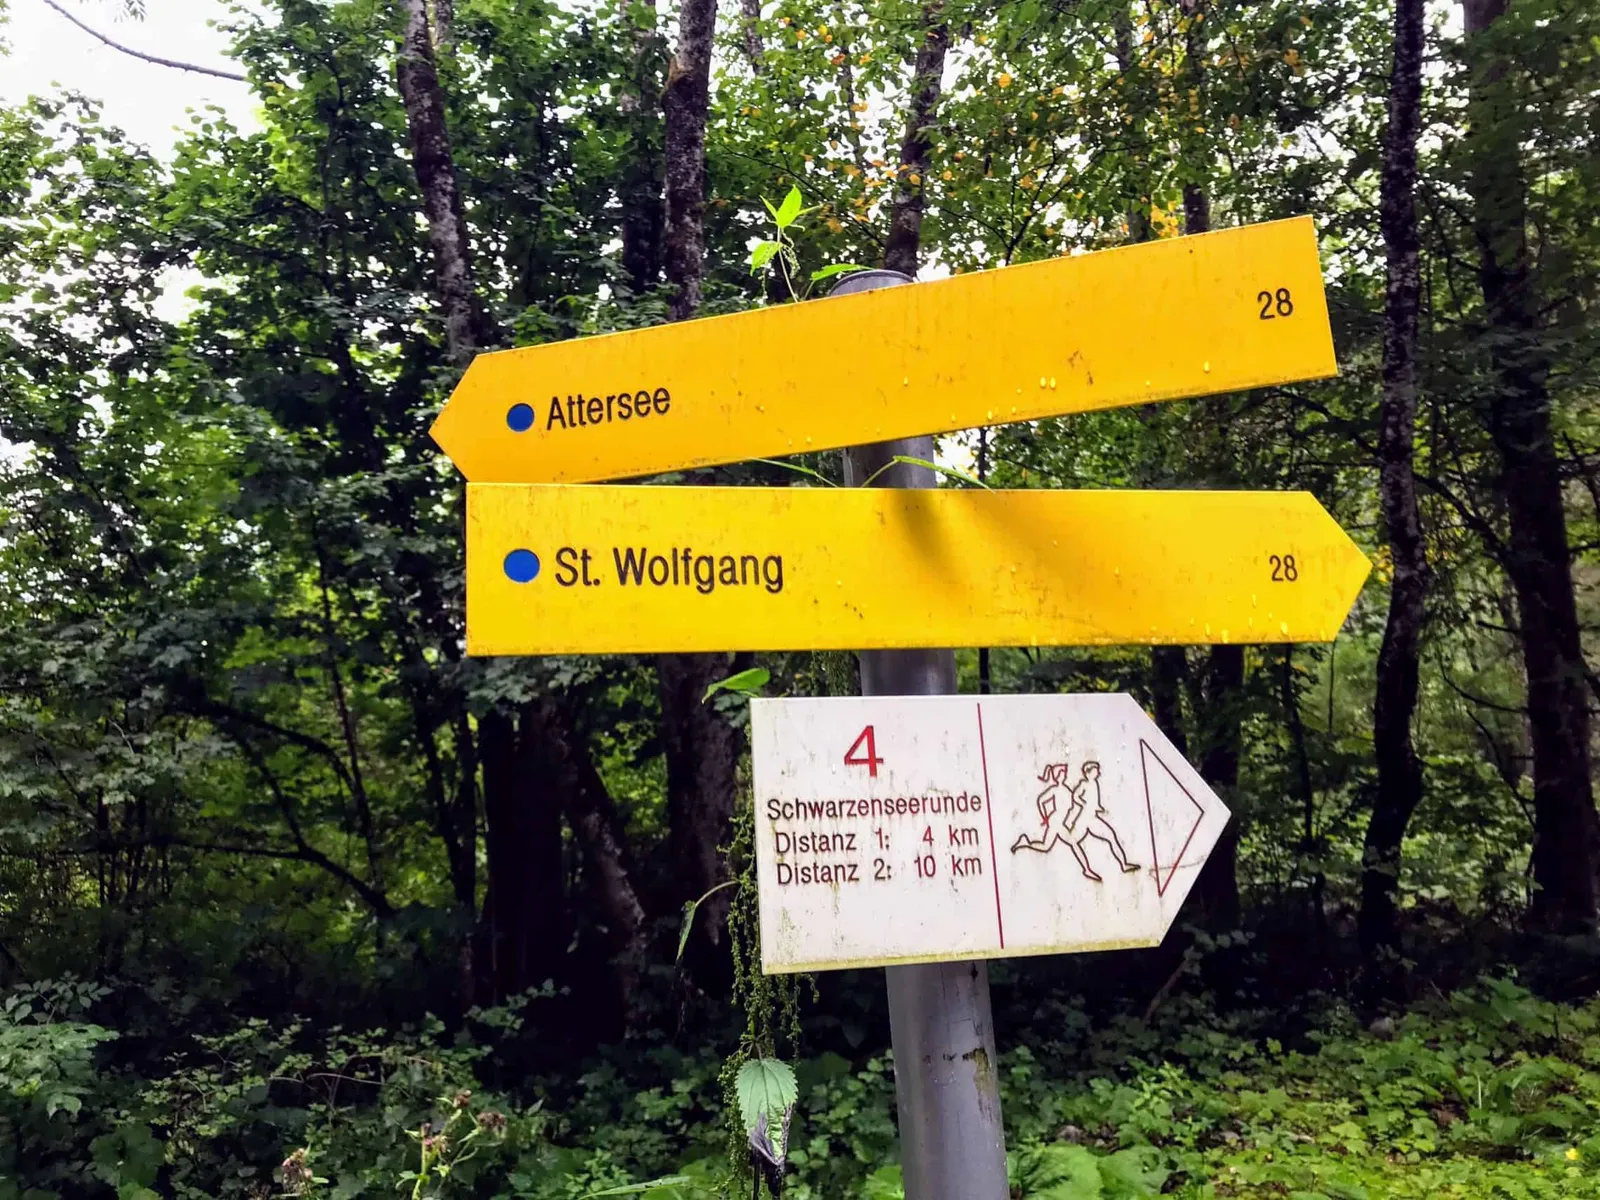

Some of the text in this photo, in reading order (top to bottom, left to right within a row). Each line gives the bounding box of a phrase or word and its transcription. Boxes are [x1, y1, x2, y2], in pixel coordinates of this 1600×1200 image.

[1257, 288, 1294, 320] 28
[546, 387, 671, 431] Attersee
[555, 547, 784, 594] St. Wolfgang
[1269, 554, 1298, 583] 28
[844, 725, 884, 777] 4
[767, 792, 982, 821] Schwarzenseerunde
[775, 824, 980, 854] Distanz 1: 4 km
[777, 854, 982, 886] Distanz 2: 10 km
